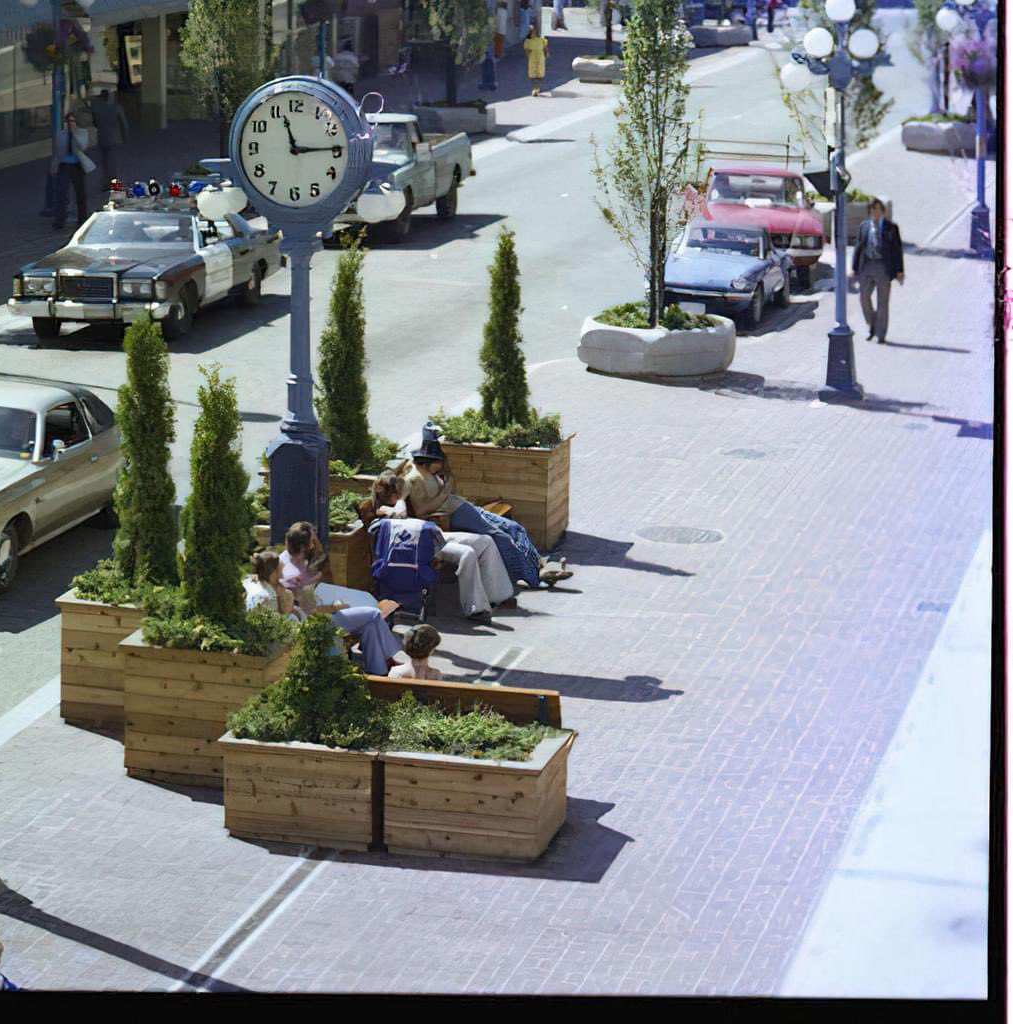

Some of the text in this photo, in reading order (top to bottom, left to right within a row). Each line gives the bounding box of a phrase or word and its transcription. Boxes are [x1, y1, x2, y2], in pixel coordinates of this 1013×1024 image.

[271, 105, 281, 118] 11
[289, 99, 304, 113] 12
[252, 120, 267, 133] 10
[249, 142, 259, 156] 9
[254, 163, 266, 178] 8
[268, 181, 277, 195] 7
[289, 187, 300, 201] 6
[310, 183, 320, 197] 5
